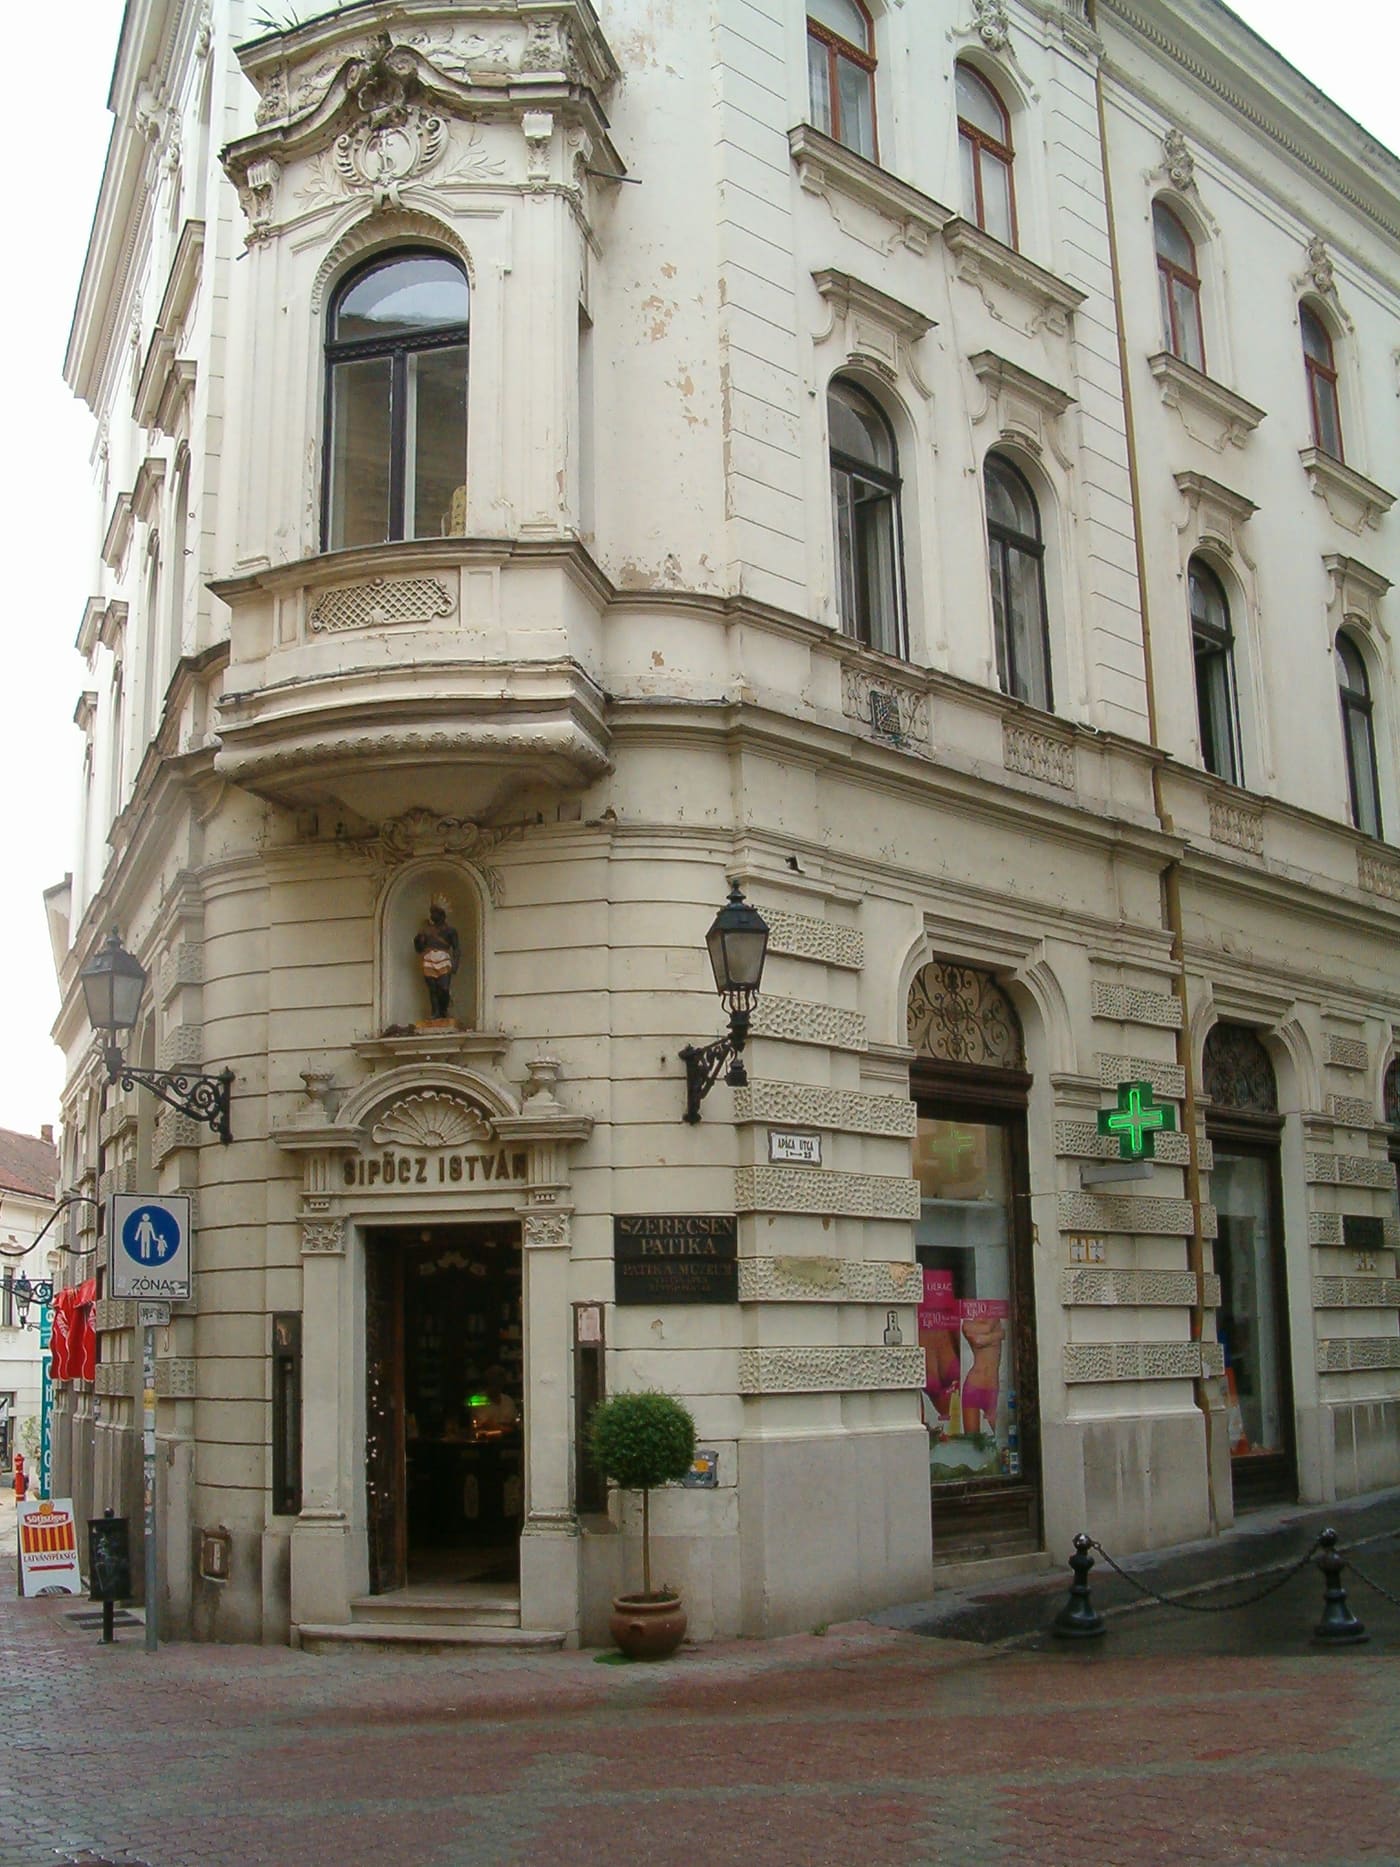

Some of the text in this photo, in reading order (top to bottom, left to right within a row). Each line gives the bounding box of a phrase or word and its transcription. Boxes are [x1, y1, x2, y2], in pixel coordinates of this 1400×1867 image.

[800, 1139, 814, 1151] UTCA
[439, 1149, 527, 1183] ISTVÁN
[619, 1218, 734, 1235] SZERECSEN
[641, 1237, 717, 1255] PATIKA
[131, 1276, 170, 1290] ZÓNA
